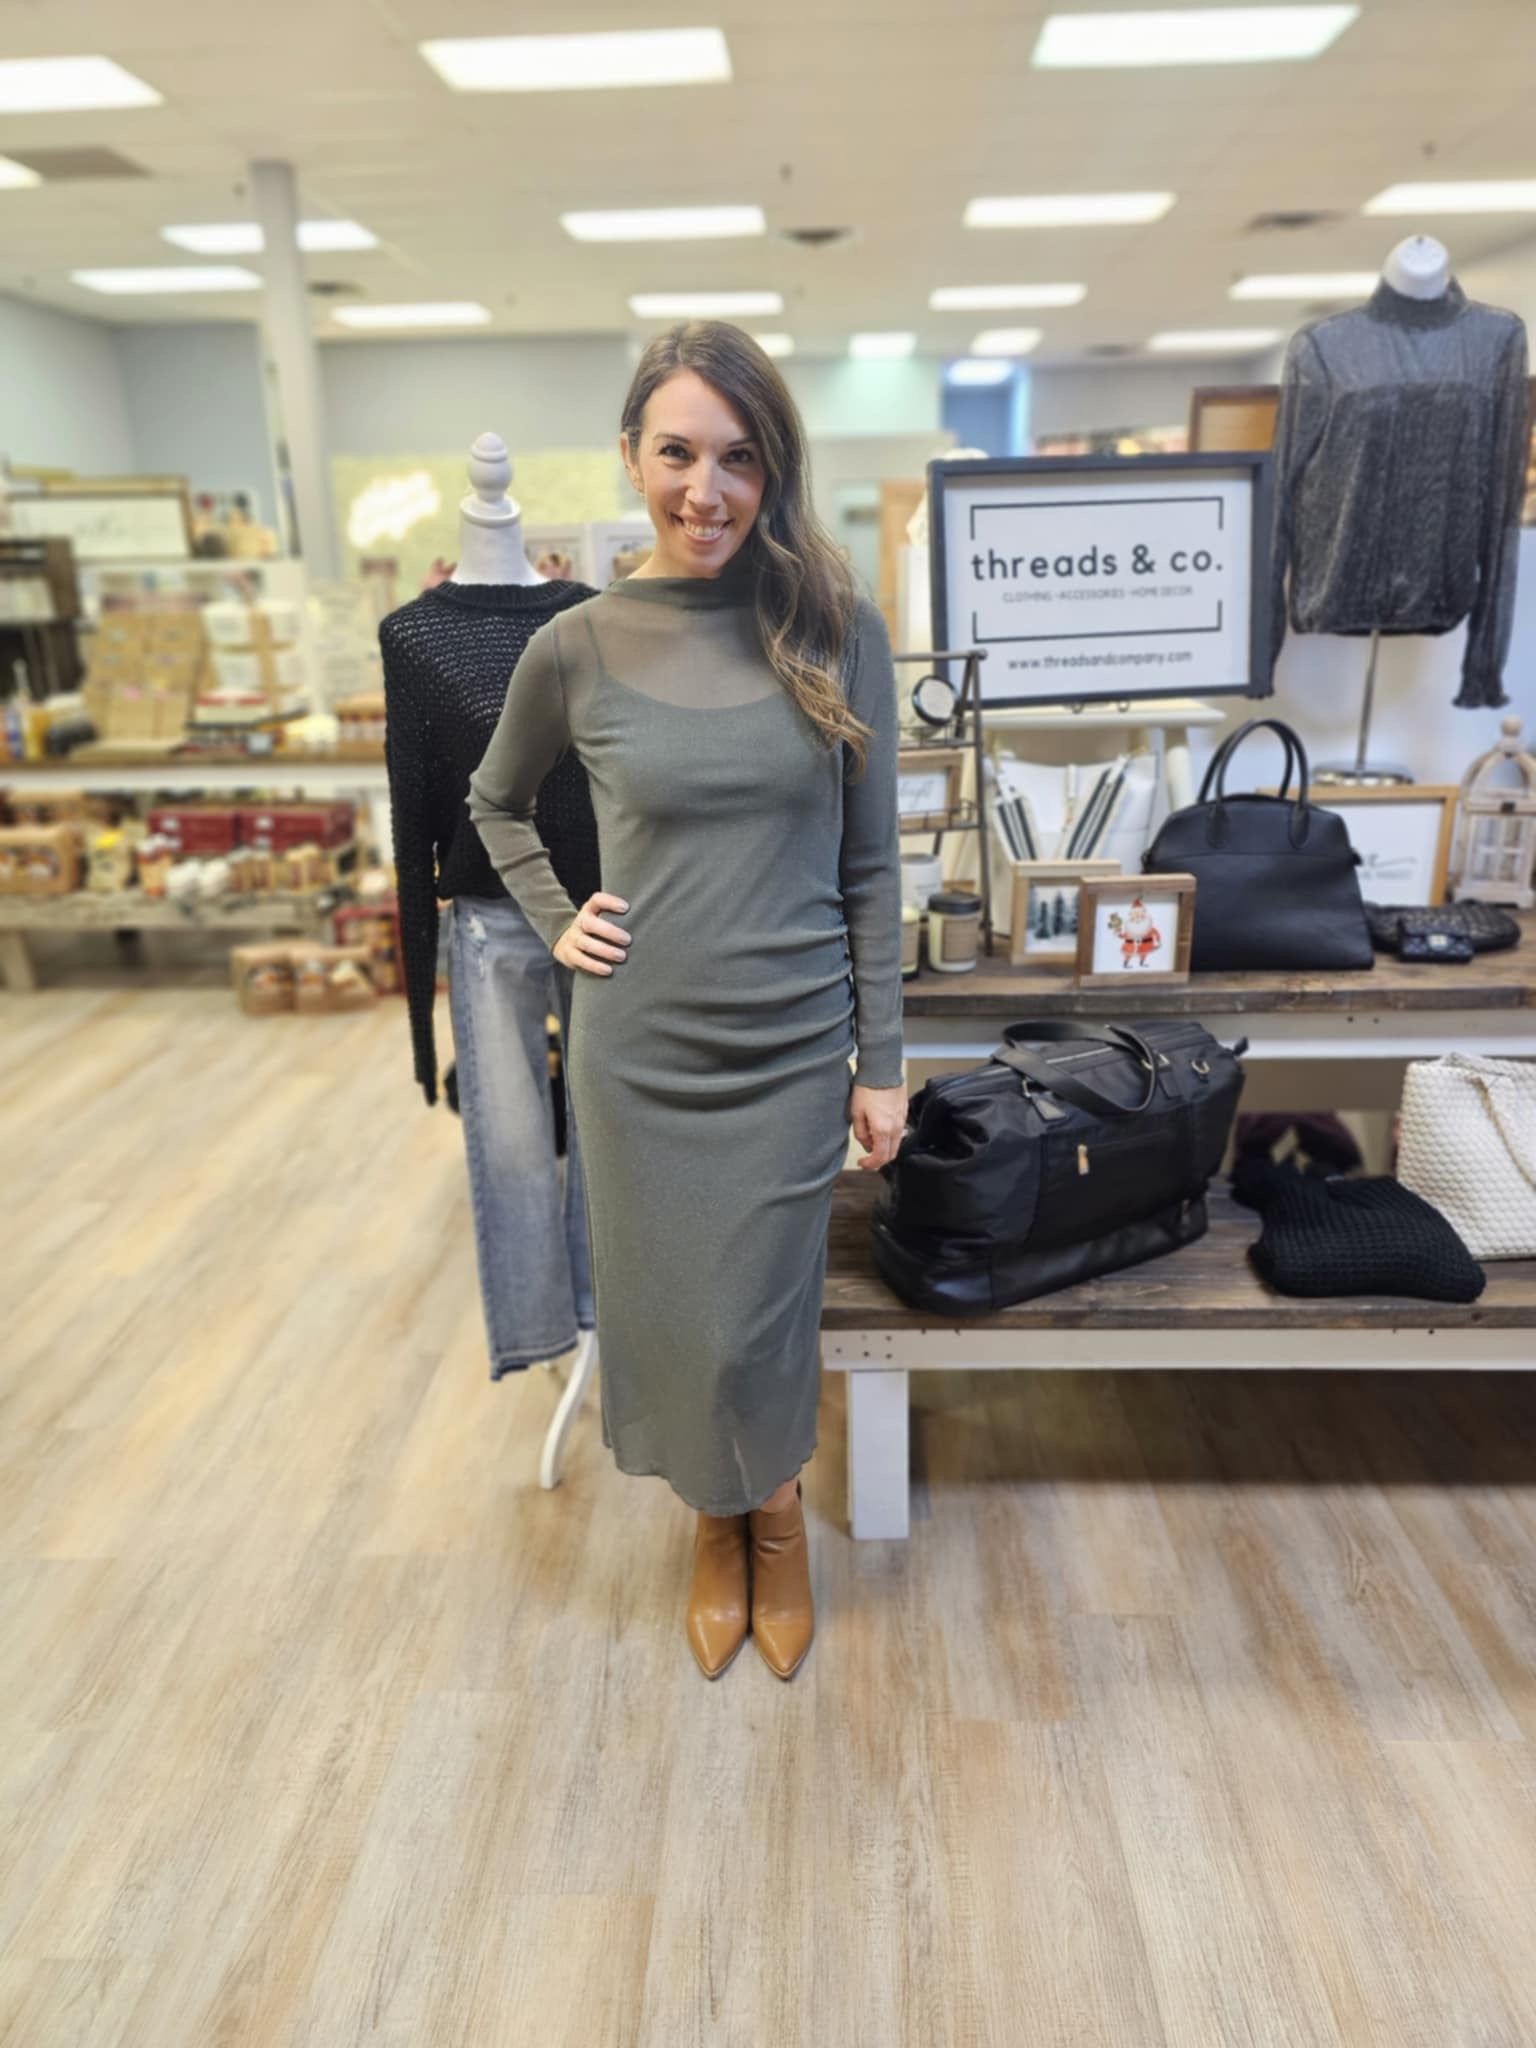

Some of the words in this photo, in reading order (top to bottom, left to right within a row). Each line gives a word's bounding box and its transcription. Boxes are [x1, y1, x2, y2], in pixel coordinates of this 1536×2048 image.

[971, 545, 1117, 580] threads
[1131, 543, 1155, 575] &
[1170, 550, 1222, 573] co.
[1008, 650, 1192, 669] www.threadsandcompany.com
